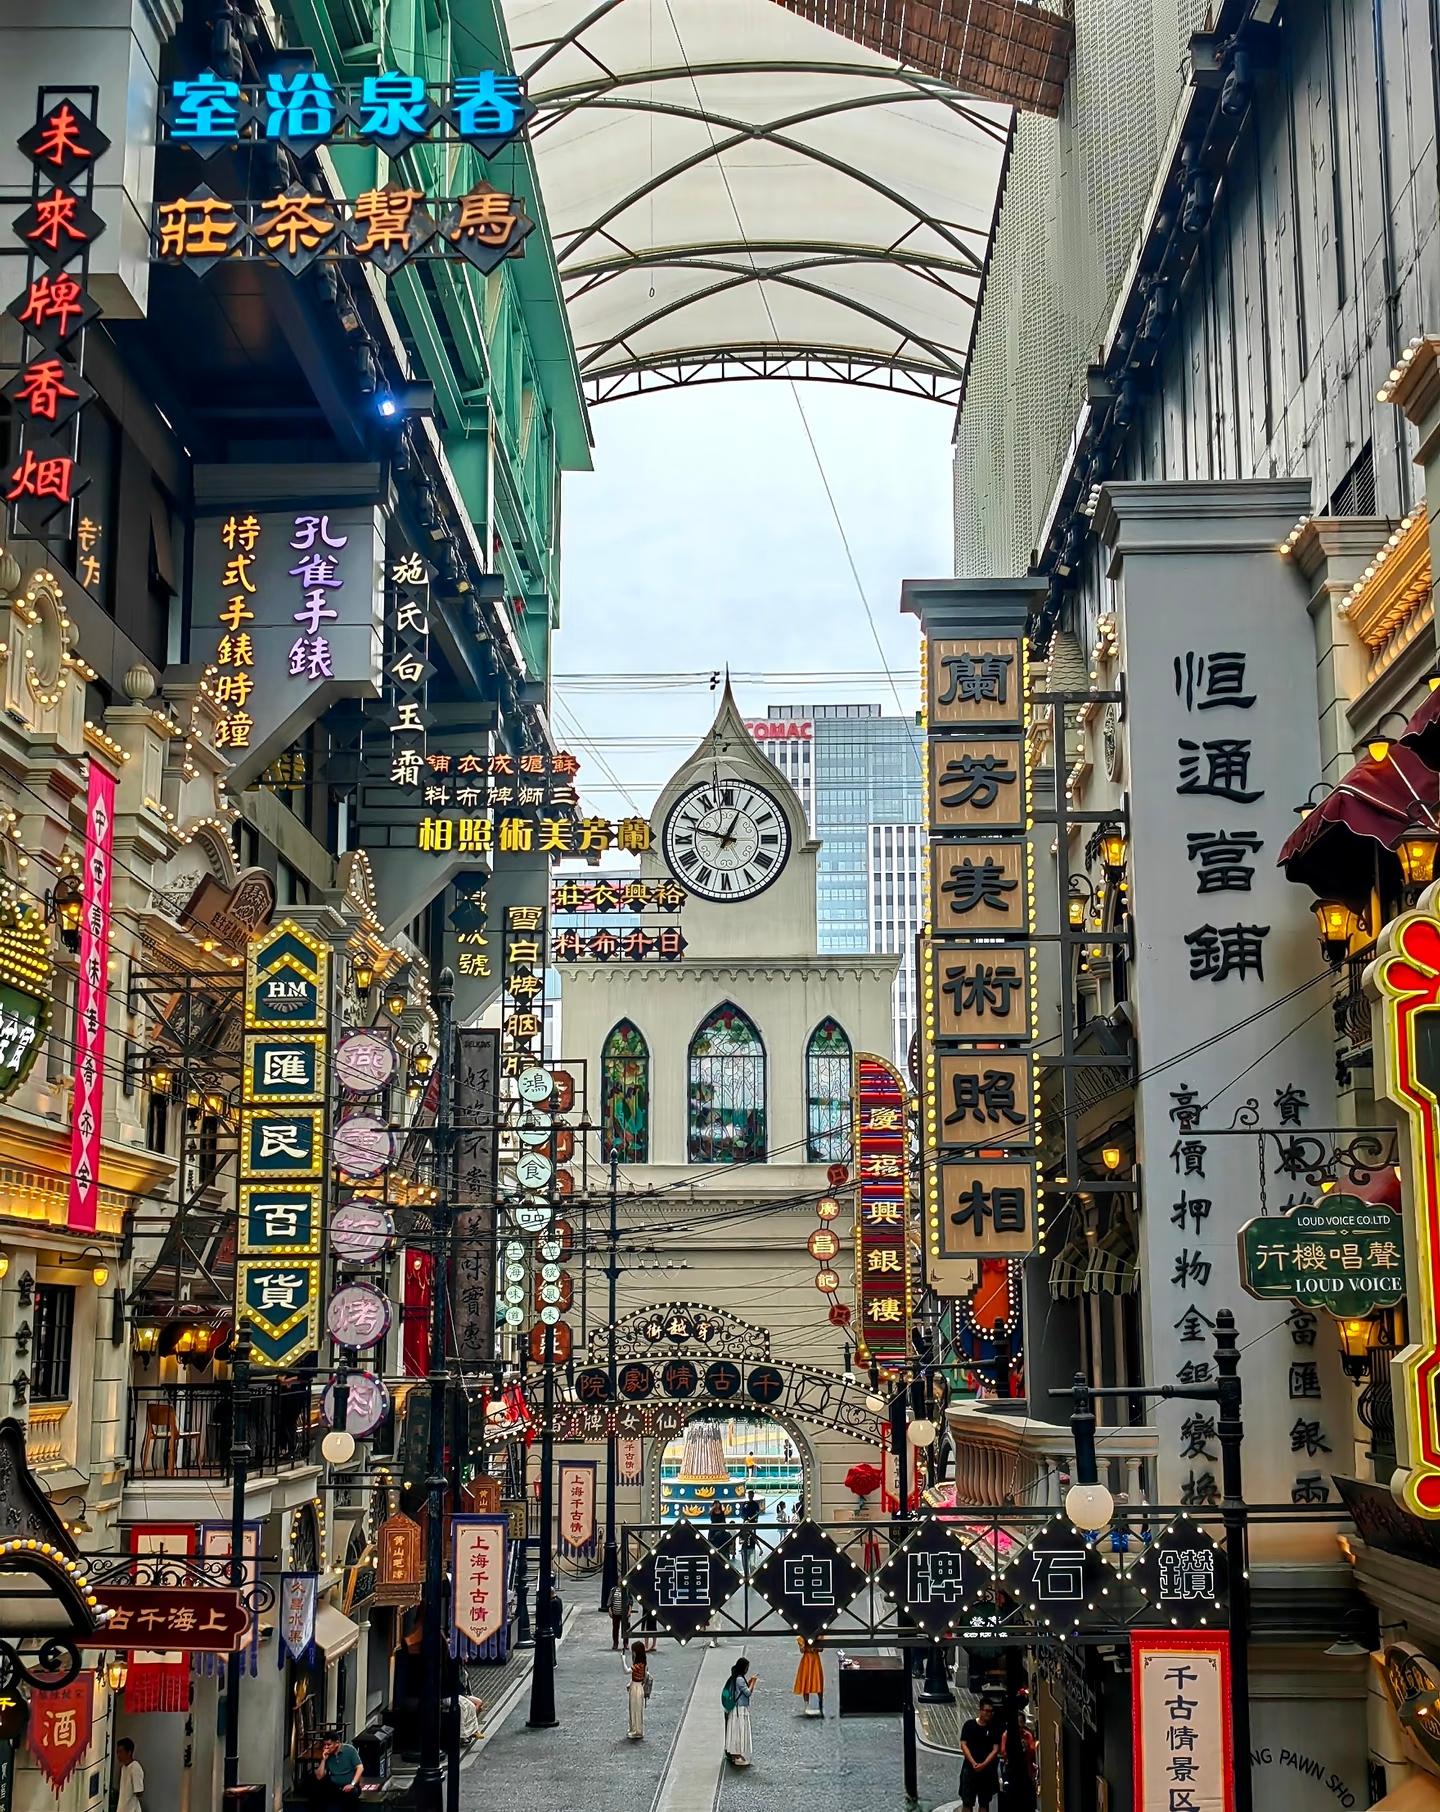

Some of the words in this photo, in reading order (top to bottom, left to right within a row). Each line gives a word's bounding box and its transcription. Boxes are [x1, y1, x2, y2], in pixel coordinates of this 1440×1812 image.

[267, 980, 308, 998] HM
[254, 1050, 311, 1310] 匯民百貨
[1297, 1217, 1325, 1227] LOUD
[1325, 1216, 1355, 1226] VOICE
[1295, 1278, 1344, 1293] LOUD
[1348, 1277, 1402, 1292] VOICE
[470, 1535, 489, 1623] 上海千古情
[43, 1709, 76, 1749] 酒
[1164, 1664, 1201, 1812] 千古情景区
[1280, 1749, 1325, 1780] PAWN
